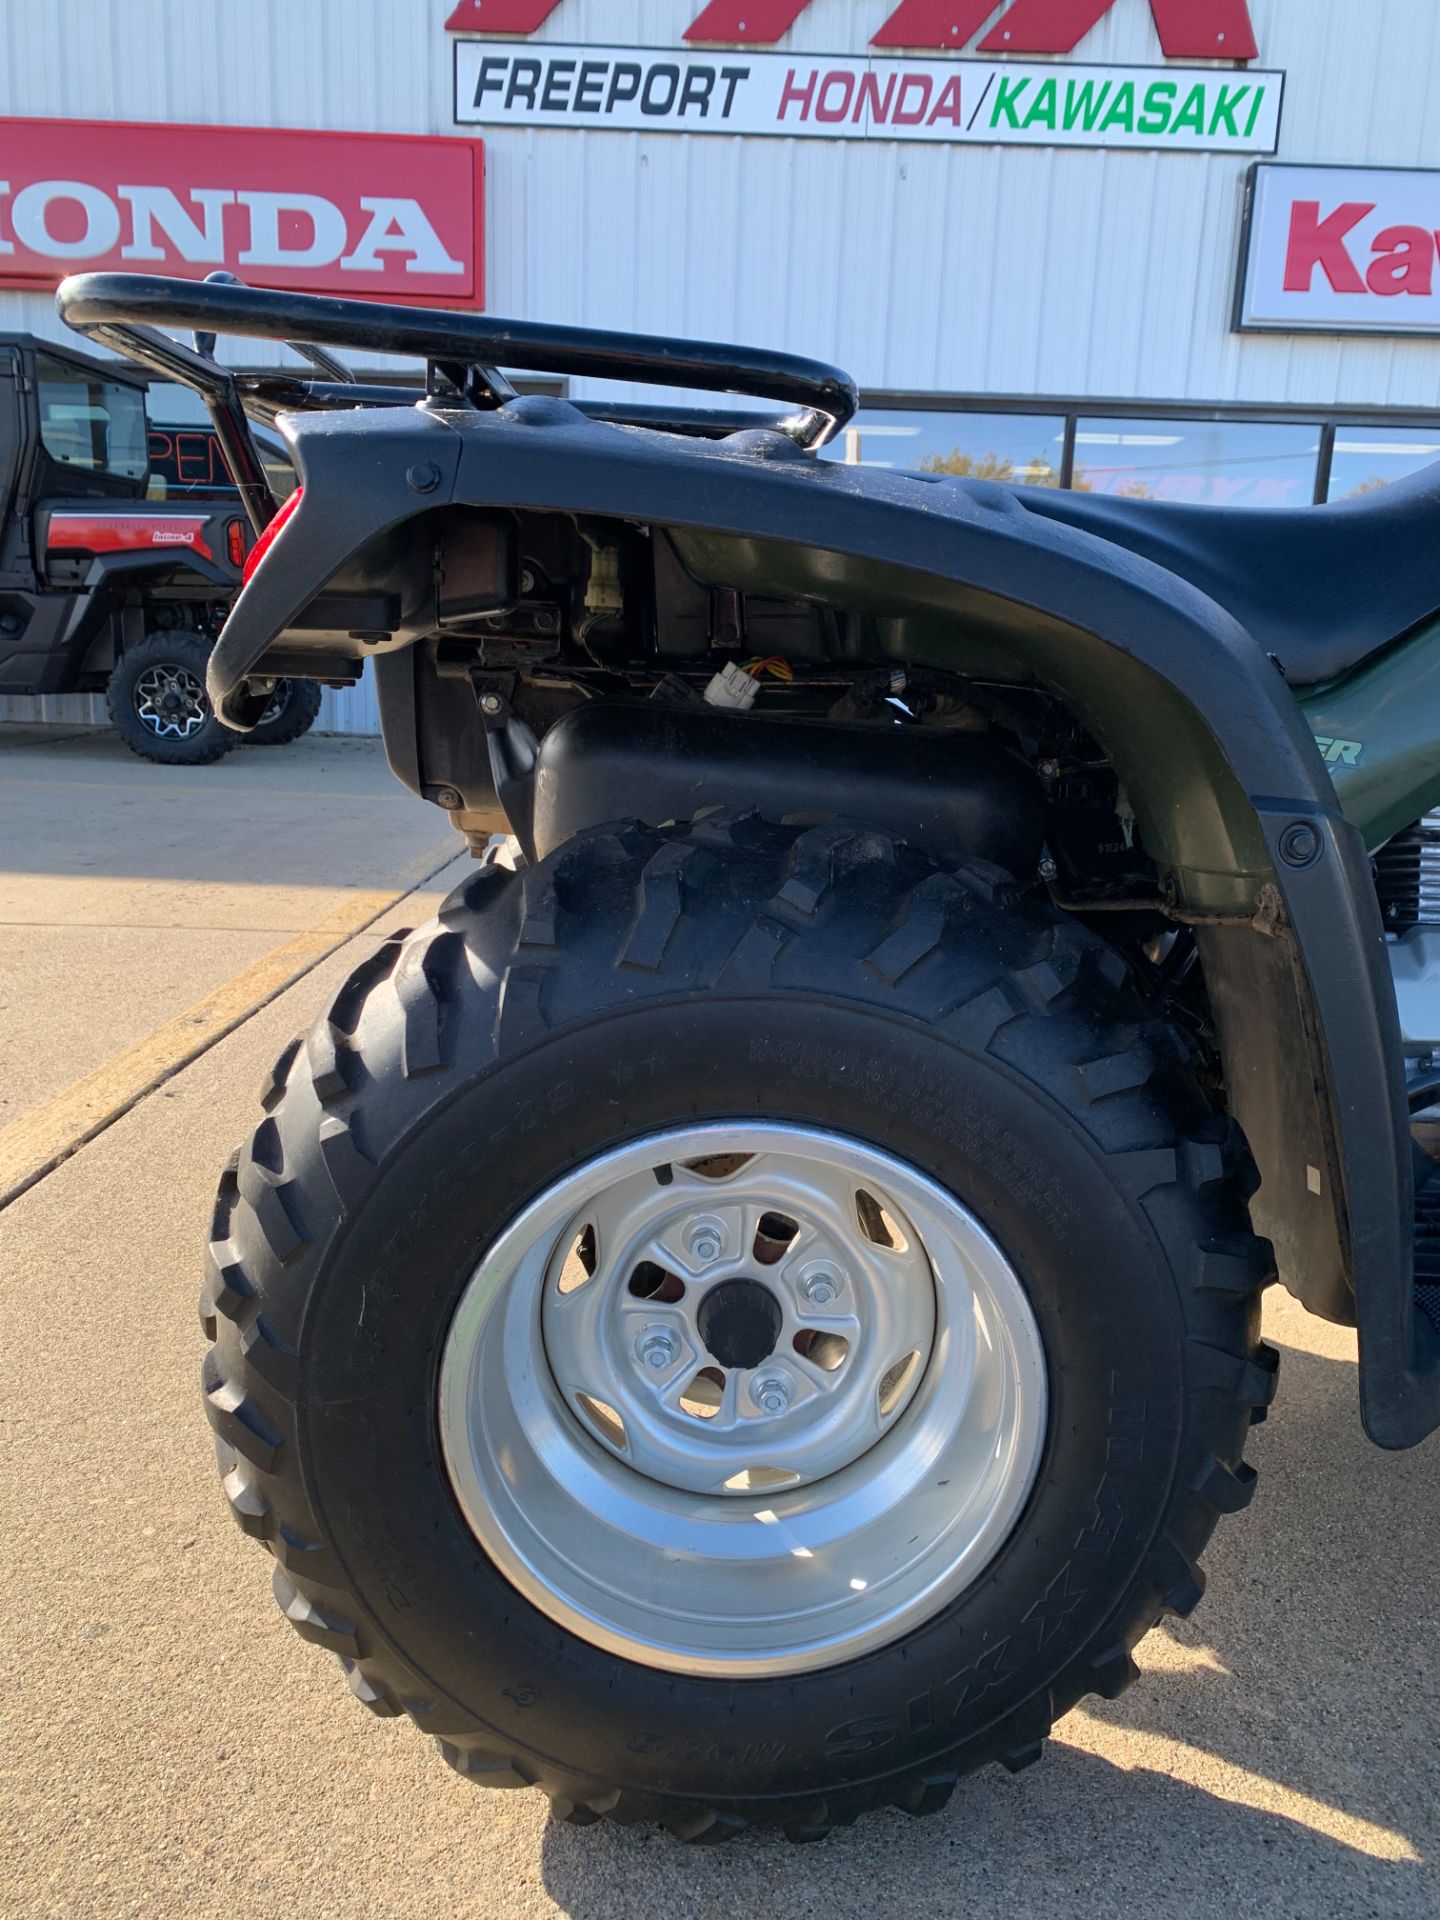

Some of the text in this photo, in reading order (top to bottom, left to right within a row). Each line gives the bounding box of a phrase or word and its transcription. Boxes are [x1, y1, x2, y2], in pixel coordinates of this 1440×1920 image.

[473, 56, 751, 118] FREEPORT
[0, 179, 465, 276] ONDA
[1283, 199, 1440, 296] Ka
[149, 433, 237, 484] PEN
